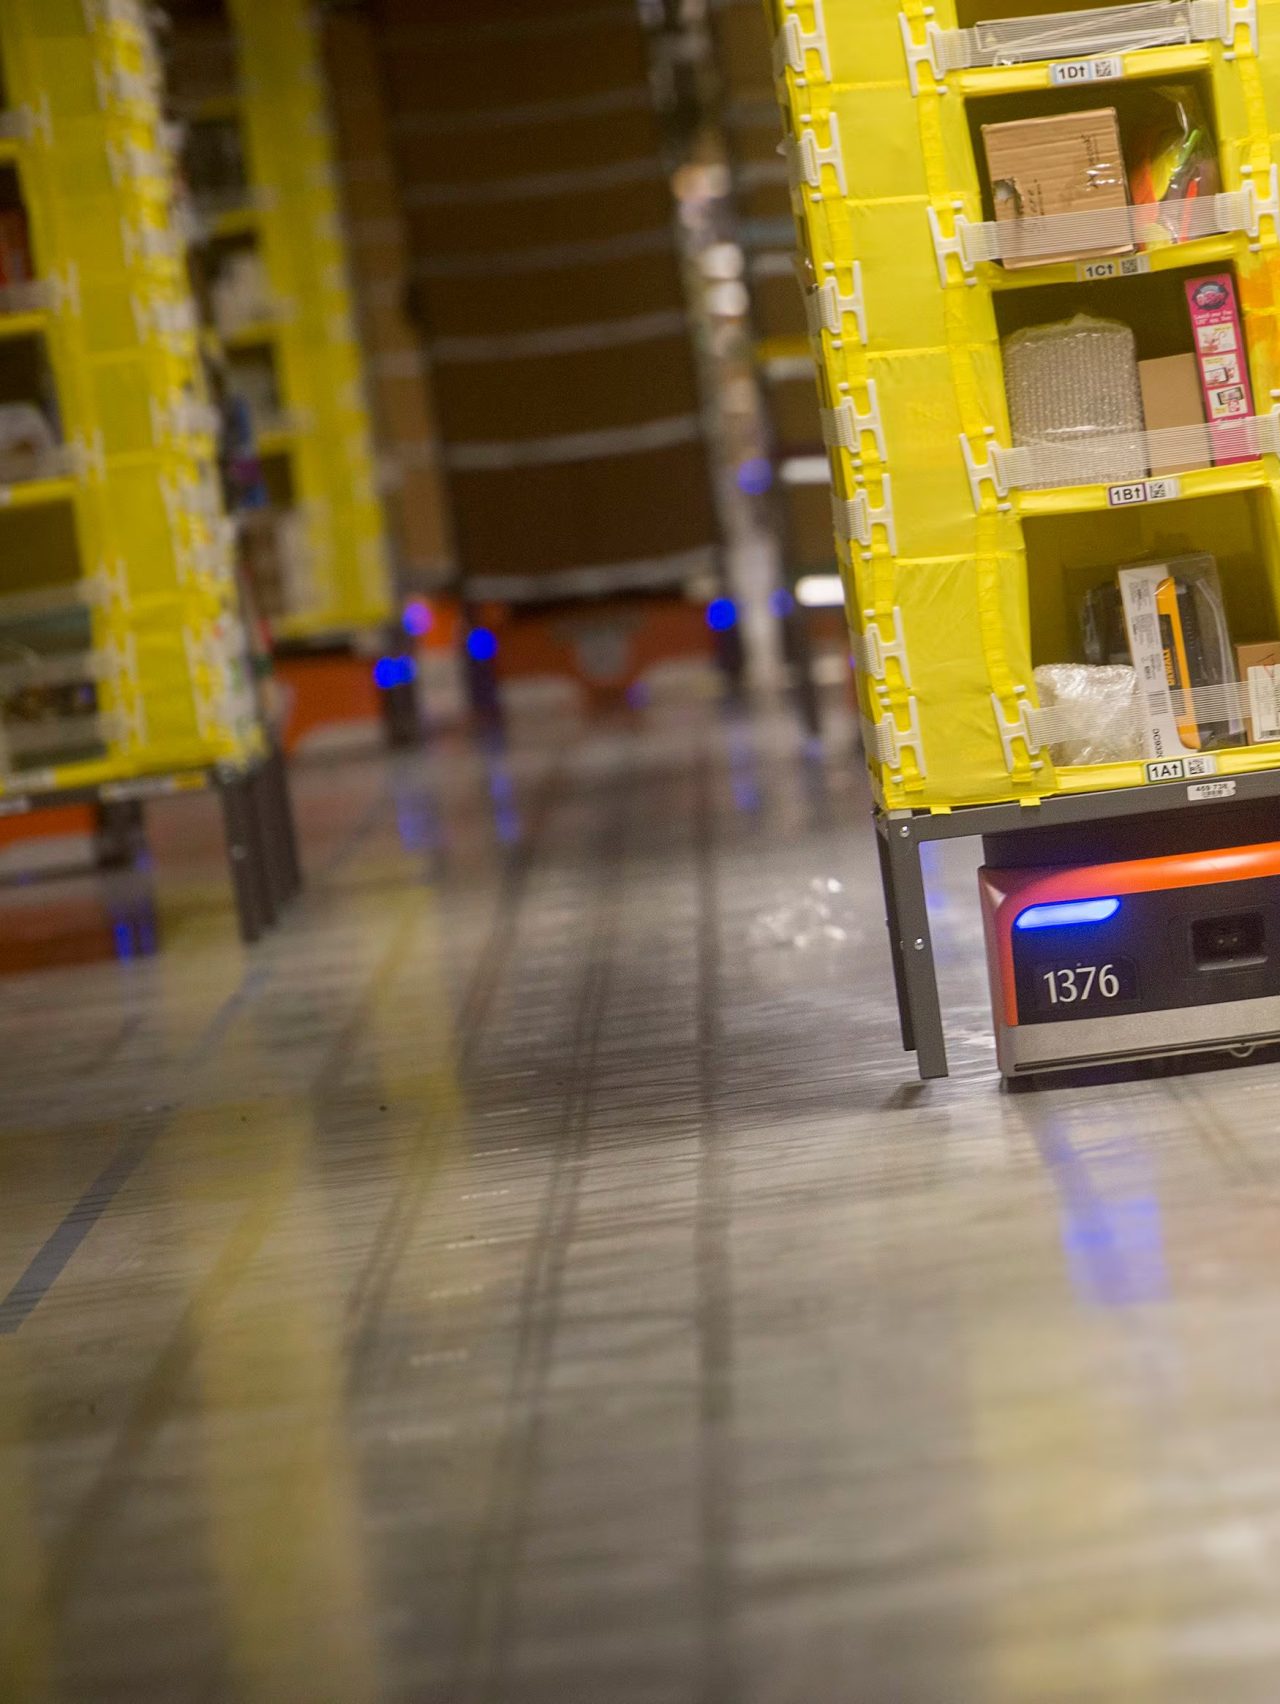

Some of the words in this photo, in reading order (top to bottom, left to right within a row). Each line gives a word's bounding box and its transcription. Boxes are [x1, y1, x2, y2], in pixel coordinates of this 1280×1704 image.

[1058, 66, 1078, 80] 1D
[1086, 264, 1106, 278] 1C
[1113, 488, 1133, 502] 1B
[1151, 765, 1171, 779] 1A
[1043, 964, 1120, 1004] 1376
